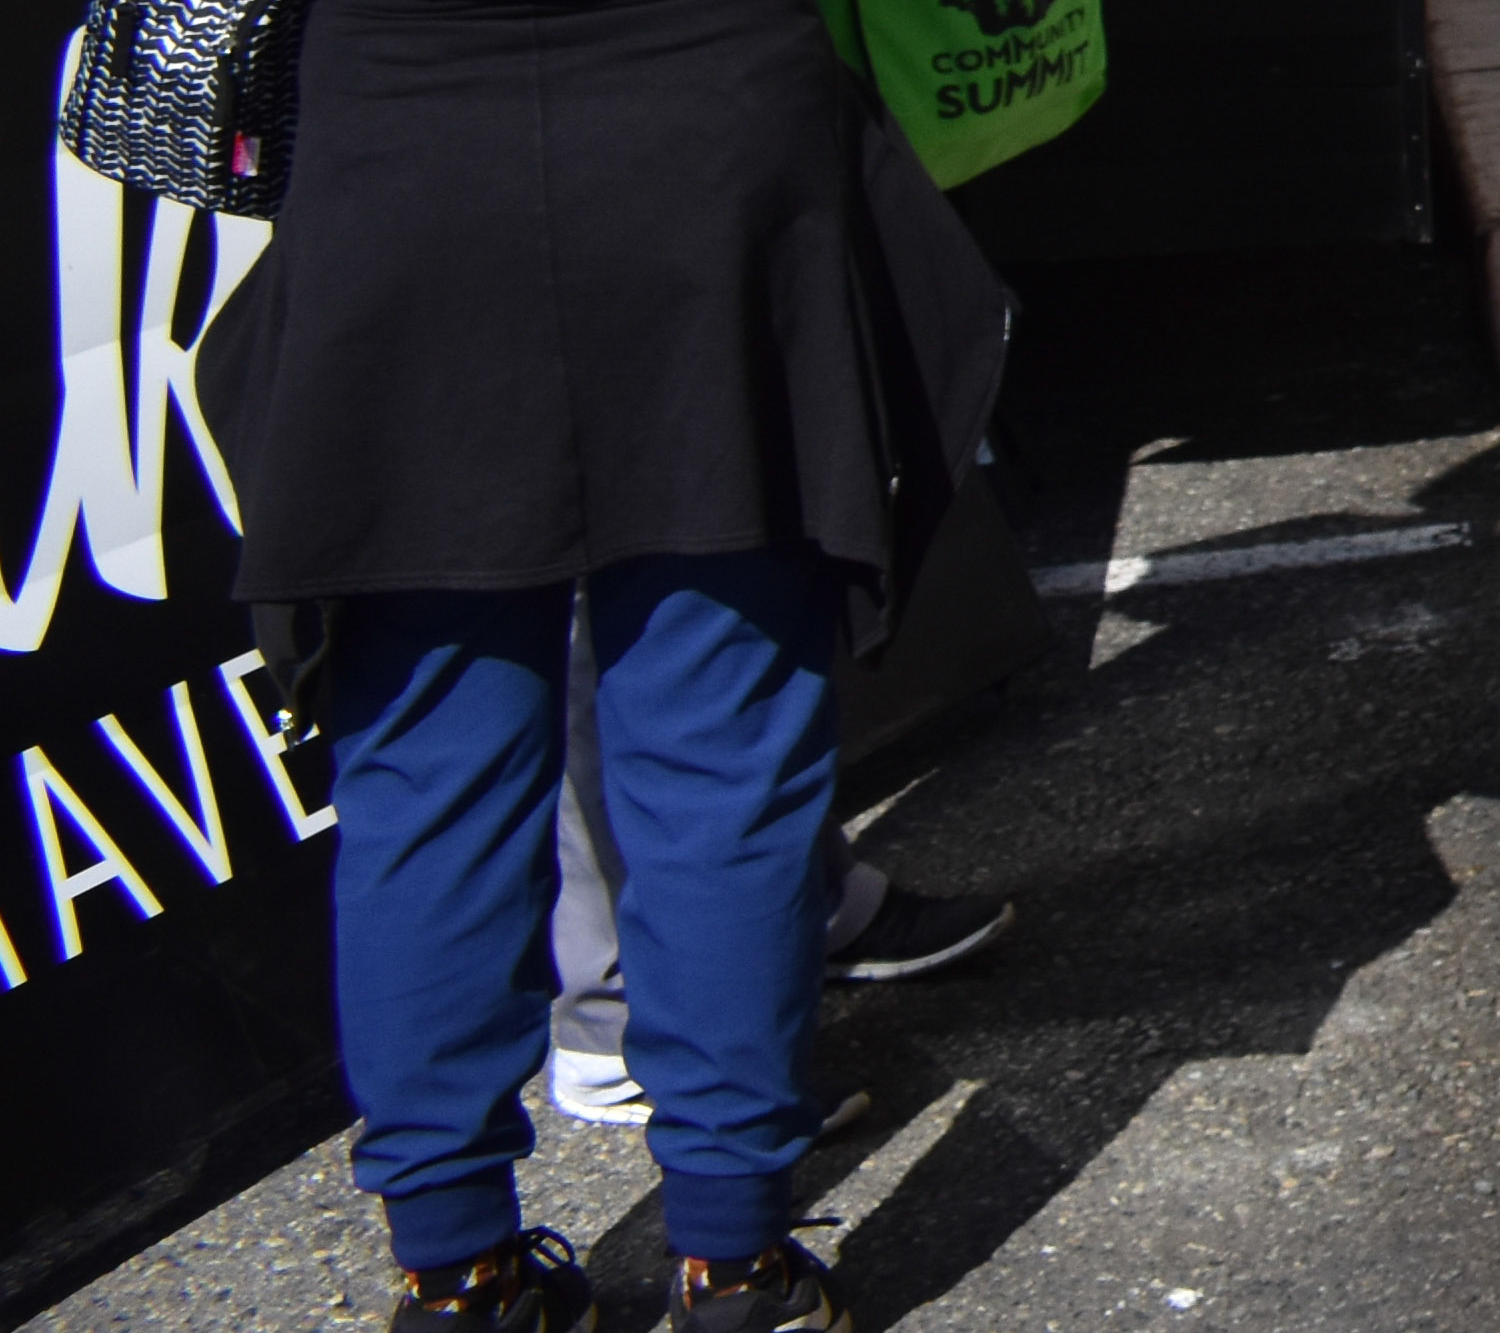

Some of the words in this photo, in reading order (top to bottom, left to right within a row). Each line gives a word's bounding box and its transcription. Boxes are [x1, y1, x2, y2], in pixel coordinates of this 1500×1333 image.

[931, 7, 1086, 75] COMMUNITY
[935, 39, 1090, 120] SUMMIT
[0, 647, 339, 991] AVE
